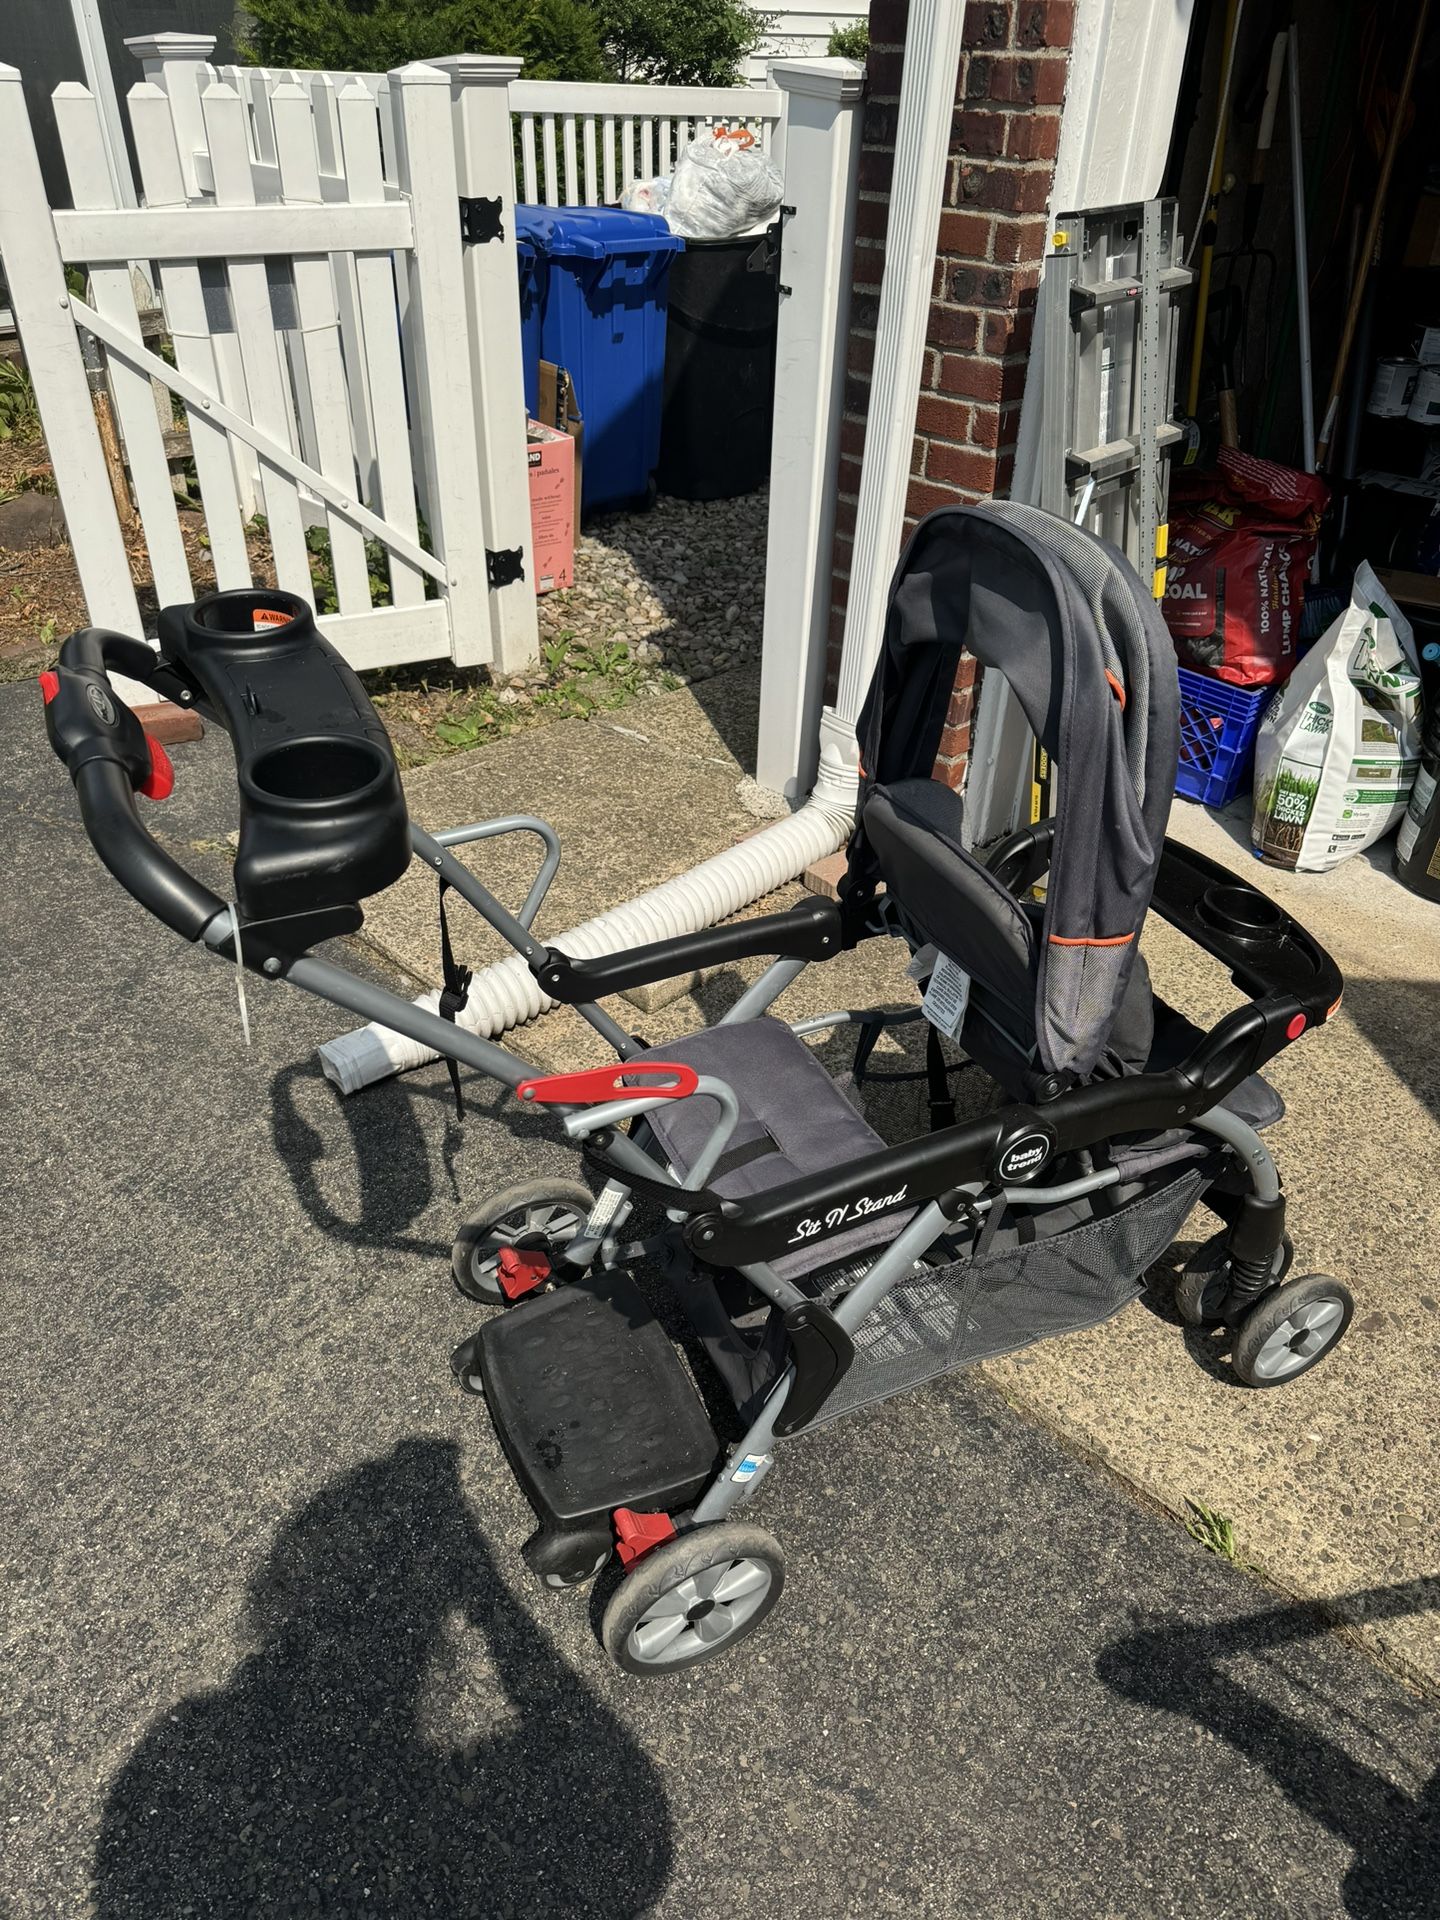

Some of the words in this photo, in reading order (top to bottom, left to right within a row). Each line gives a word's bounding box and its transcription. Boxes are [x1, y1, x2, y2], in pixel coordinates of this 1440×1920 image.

[559, 569, 567, 581] 4
[1260, 601, 1270, 634] 100%
[1277, 793, 1307, 812] 50%
[1273, 809, 1304, 825] LAWN
[1007, 1152, 1043, 1171] trend
[1010, 1146, 1043, 1163] baby
[788, 1218, 822, 1244] Sit
[846, 1183, 908, 1222] Stand
